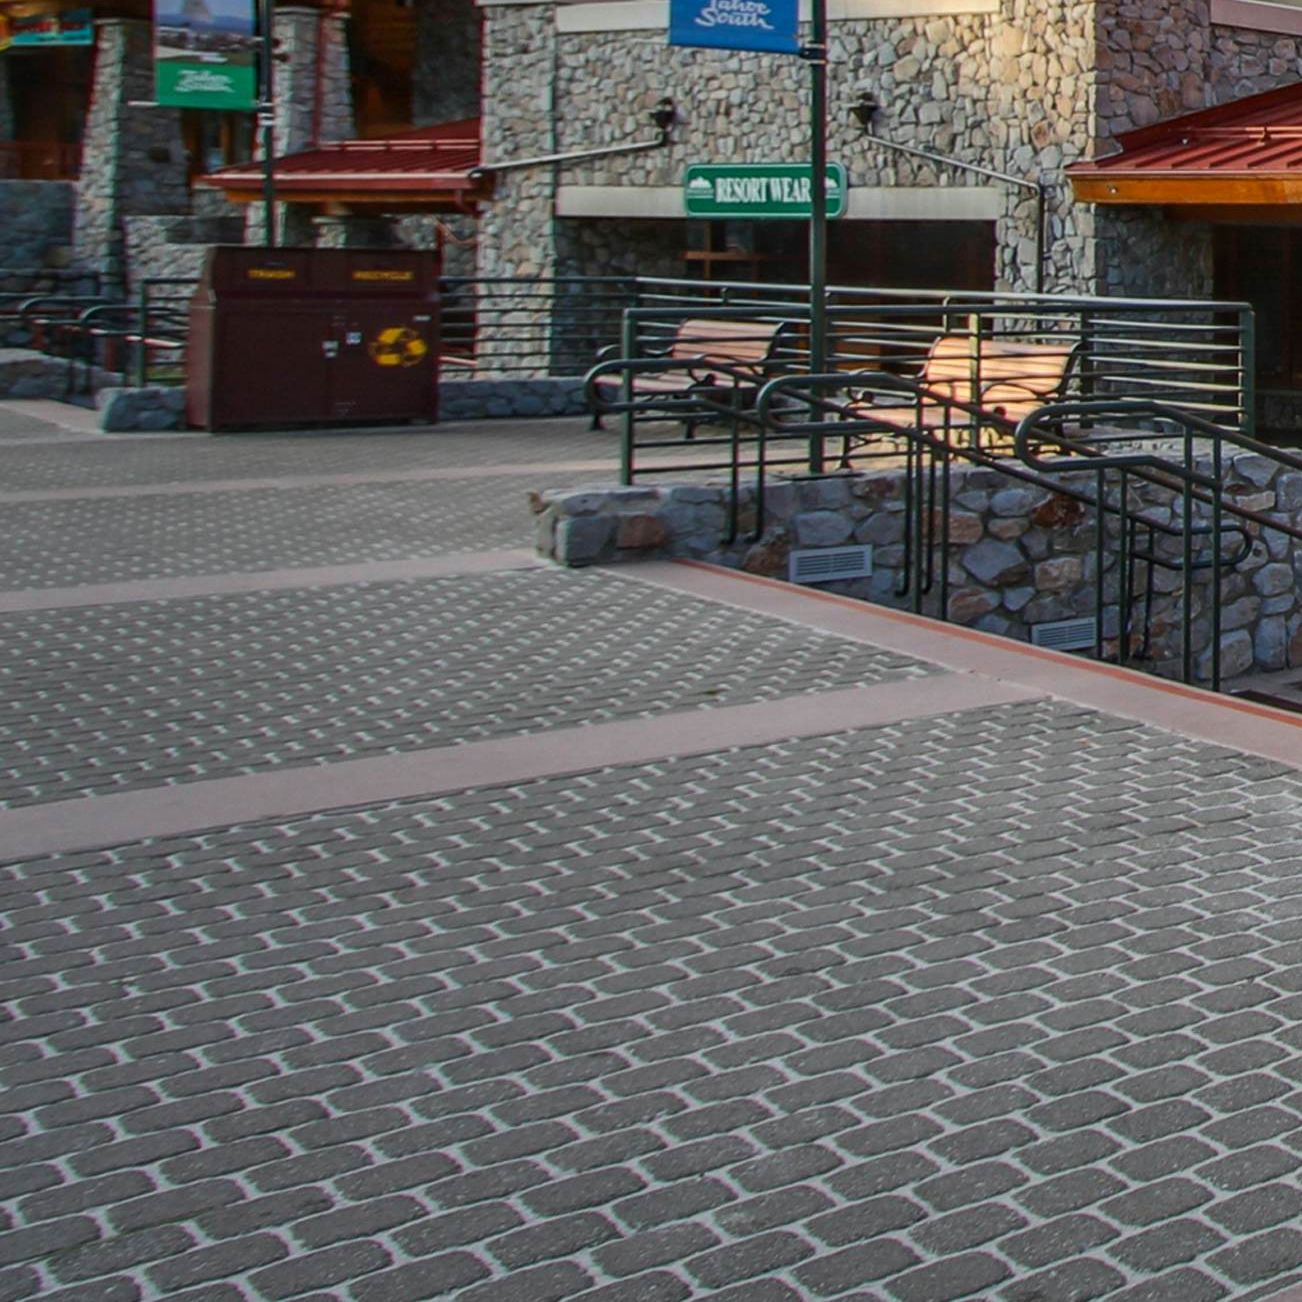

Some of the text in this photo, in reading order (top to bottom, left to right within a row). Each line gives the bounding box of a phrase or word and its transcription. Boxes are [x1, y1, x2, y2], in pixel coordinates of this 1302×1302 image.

[694, 8, 776, 30] South
[715, 177, 812, 202] RESORT WEAR
